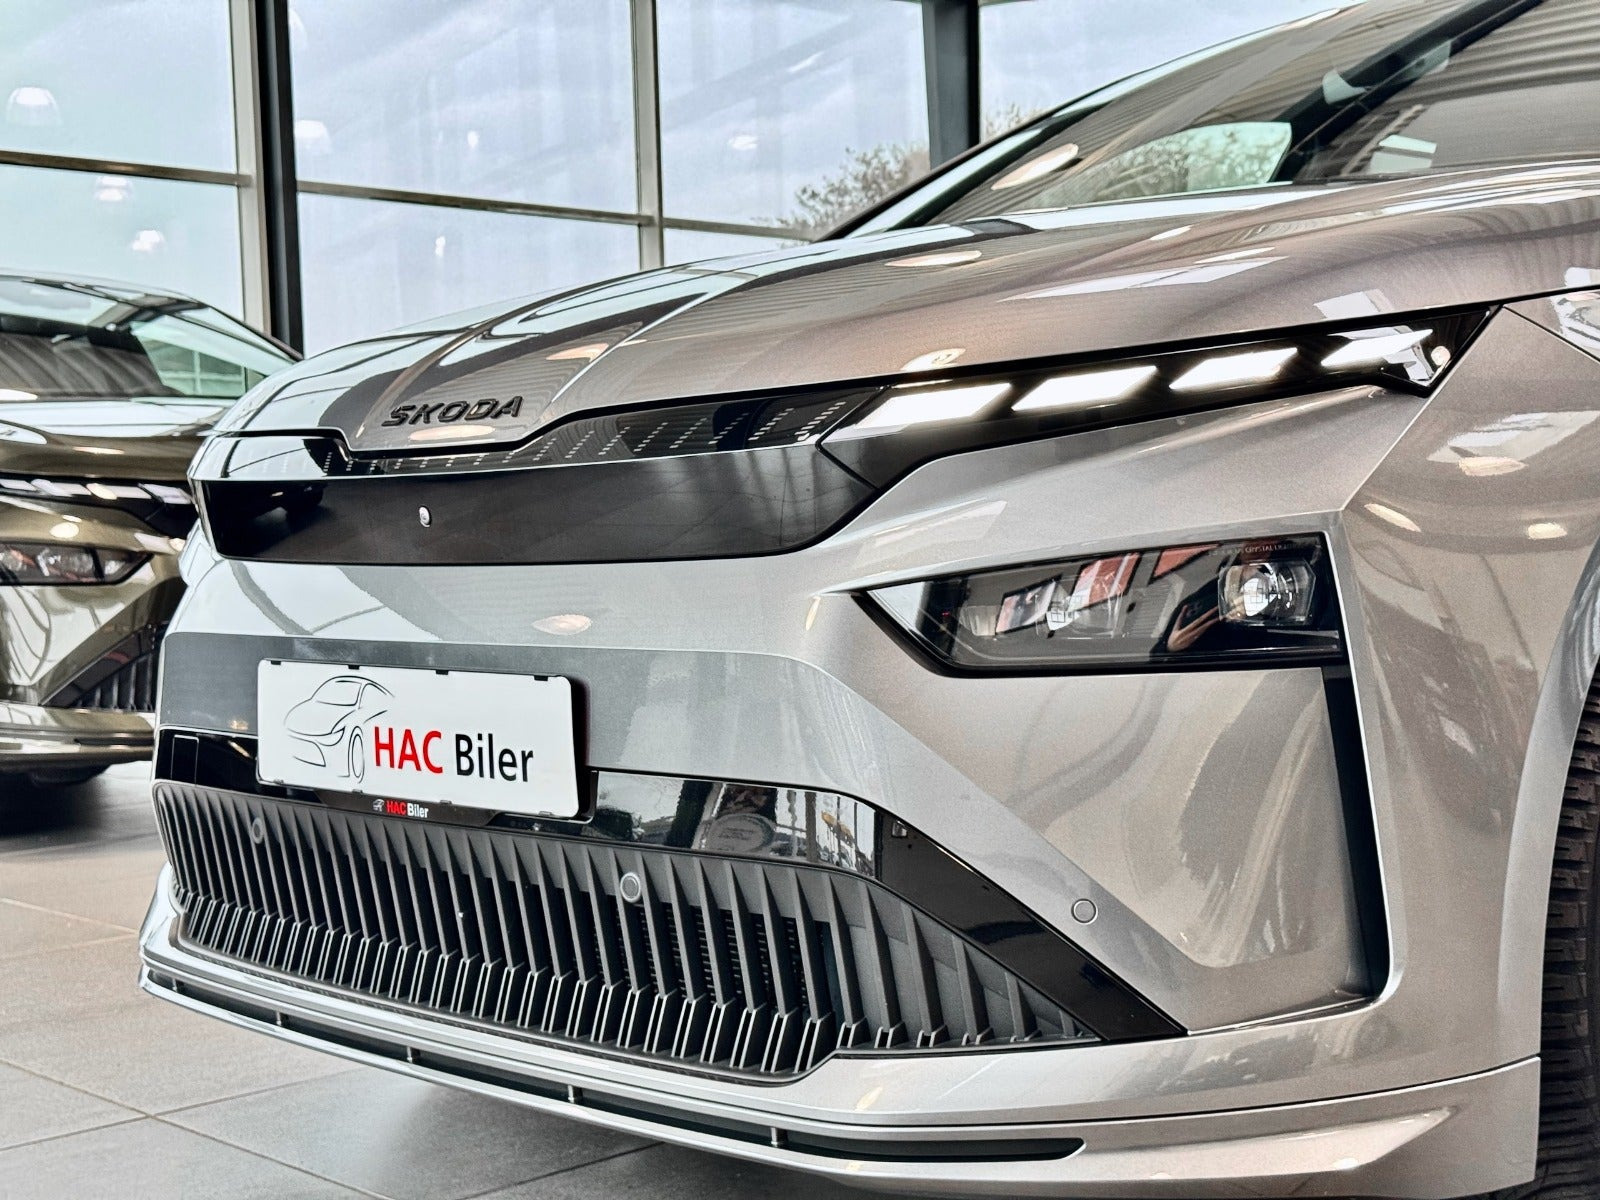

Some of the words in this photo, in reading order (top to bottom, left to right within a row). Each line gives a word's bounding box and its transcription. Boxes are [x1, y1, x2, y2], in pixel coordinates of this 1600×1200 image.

[381, 395, 523, 427] SKODA
[374, 726, 443, 774] HAC
[455, 732, 534, 782] Biler
